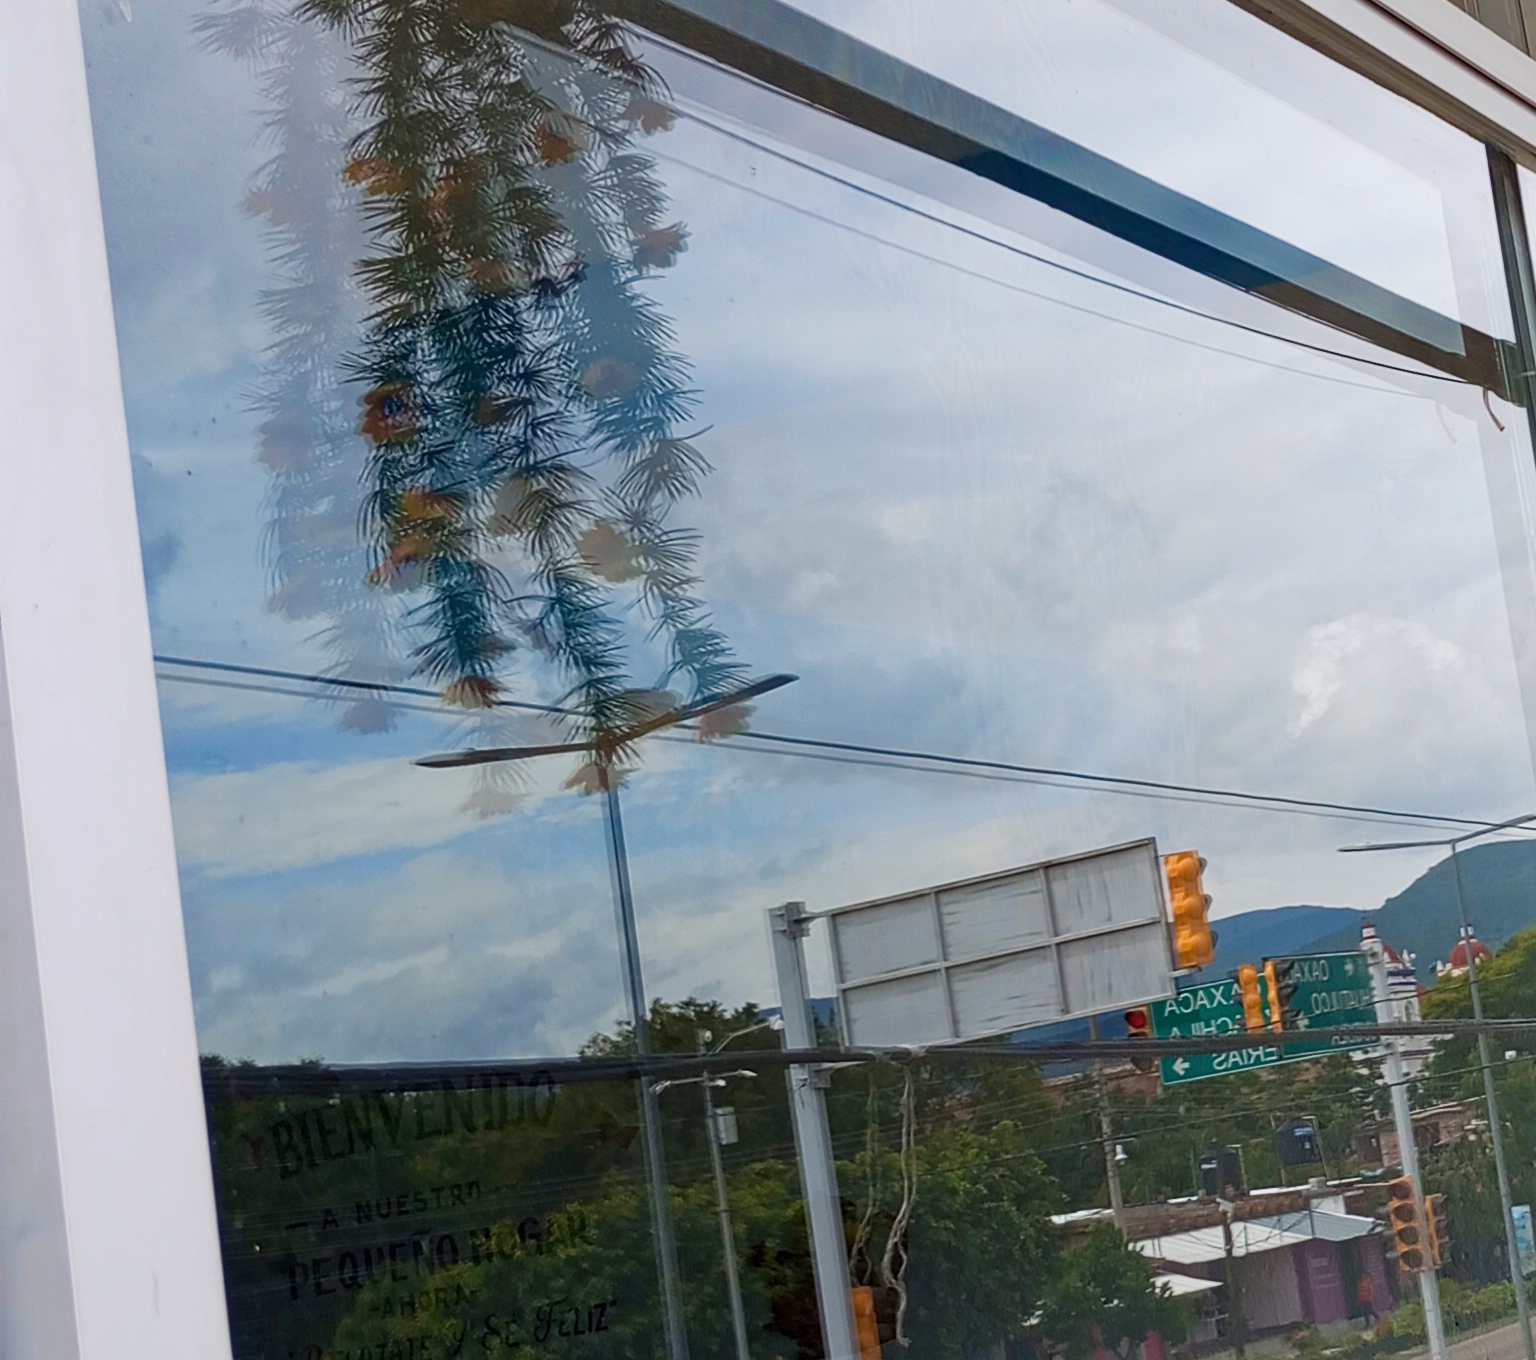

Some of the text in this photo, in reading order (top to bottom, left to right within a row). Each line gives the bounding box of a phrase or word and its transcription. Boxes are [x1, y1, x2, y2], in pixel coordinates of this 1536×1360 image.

[271, 1070, 556, 1180] BIENVENIDO
[322, 1180, 482, 1230] A NUESTRO
[284, 1209, 593, 1300] PEQUEÑO HOGAR
